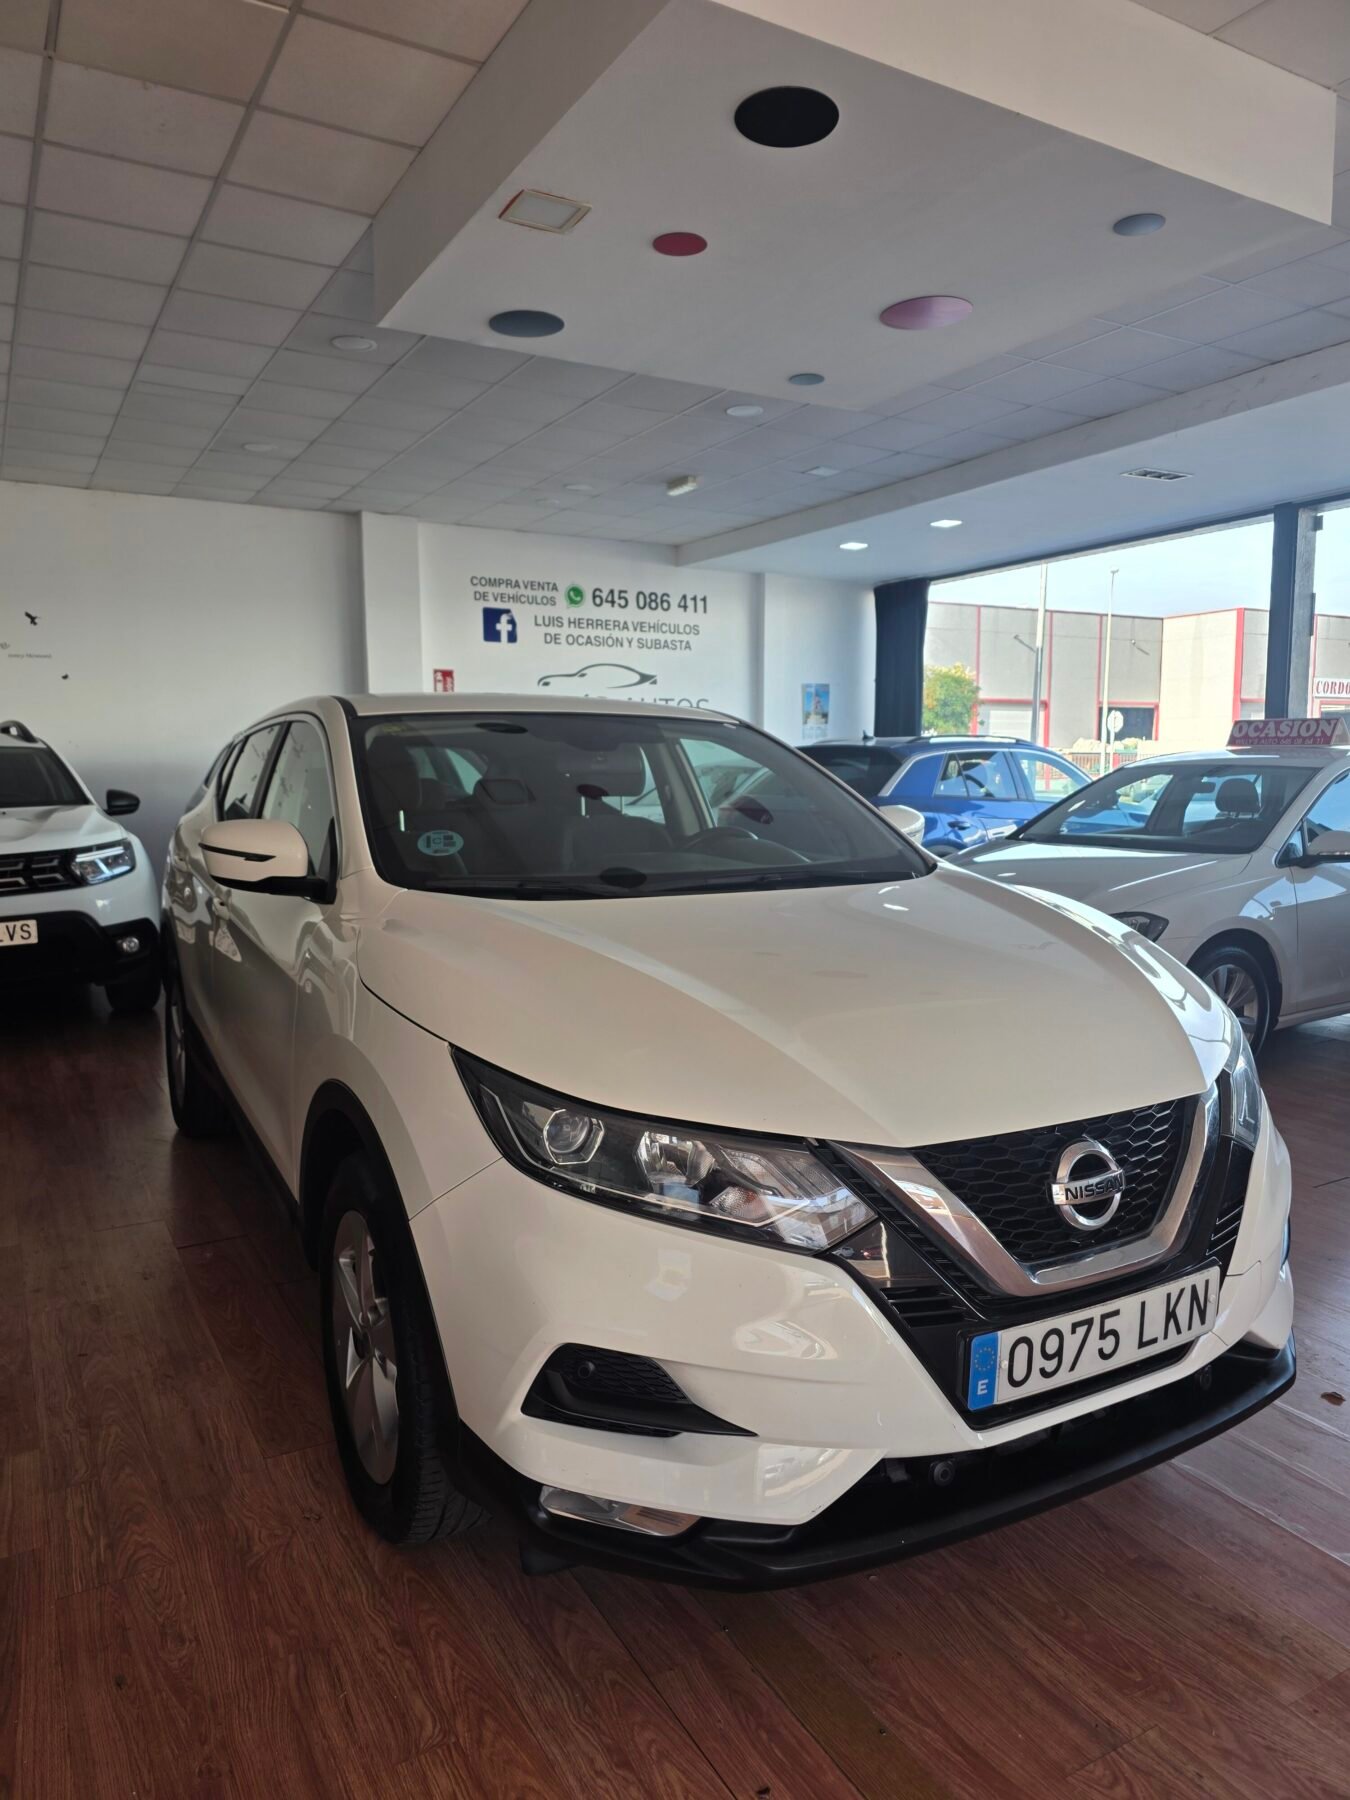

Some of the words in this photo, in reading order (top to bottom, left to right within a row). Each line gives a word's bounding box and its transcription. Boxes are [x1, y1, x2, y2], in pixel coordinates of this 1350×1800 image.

[470, 576, 521, 591] COMPRA
[521, 581, 559, 593] VENTA
[473, 590, 490, 602] DE
[492, 591, 557, 606] VEHÍCULOS
[592, 588, 629, 609] 645
[635, 591, 671, 612] 086
[677, 593, 708, 614] 411
[534, 615, 564, 628] LUIS
[567, 616, 629, 631] HERRERA
[632, 619, 700, 635] VEHÍCULOS
[544, 633, 562, 645] DE
[566, 633, 624, 649] OCASIÓN
[626, 638, 634, 648] Y
[637, 638, 692, 651] SUBASTA
[1232, 719, 1338, 738] OCASION
[0, 923, 32, 942] VS
[1065, 1173, 1122, 1200] NISSAN
[1007, 1308, 1121, 1389] 0975
[1137, 1278, 1211, 1350] LKN
[976, 1379, 989, 1396] E
